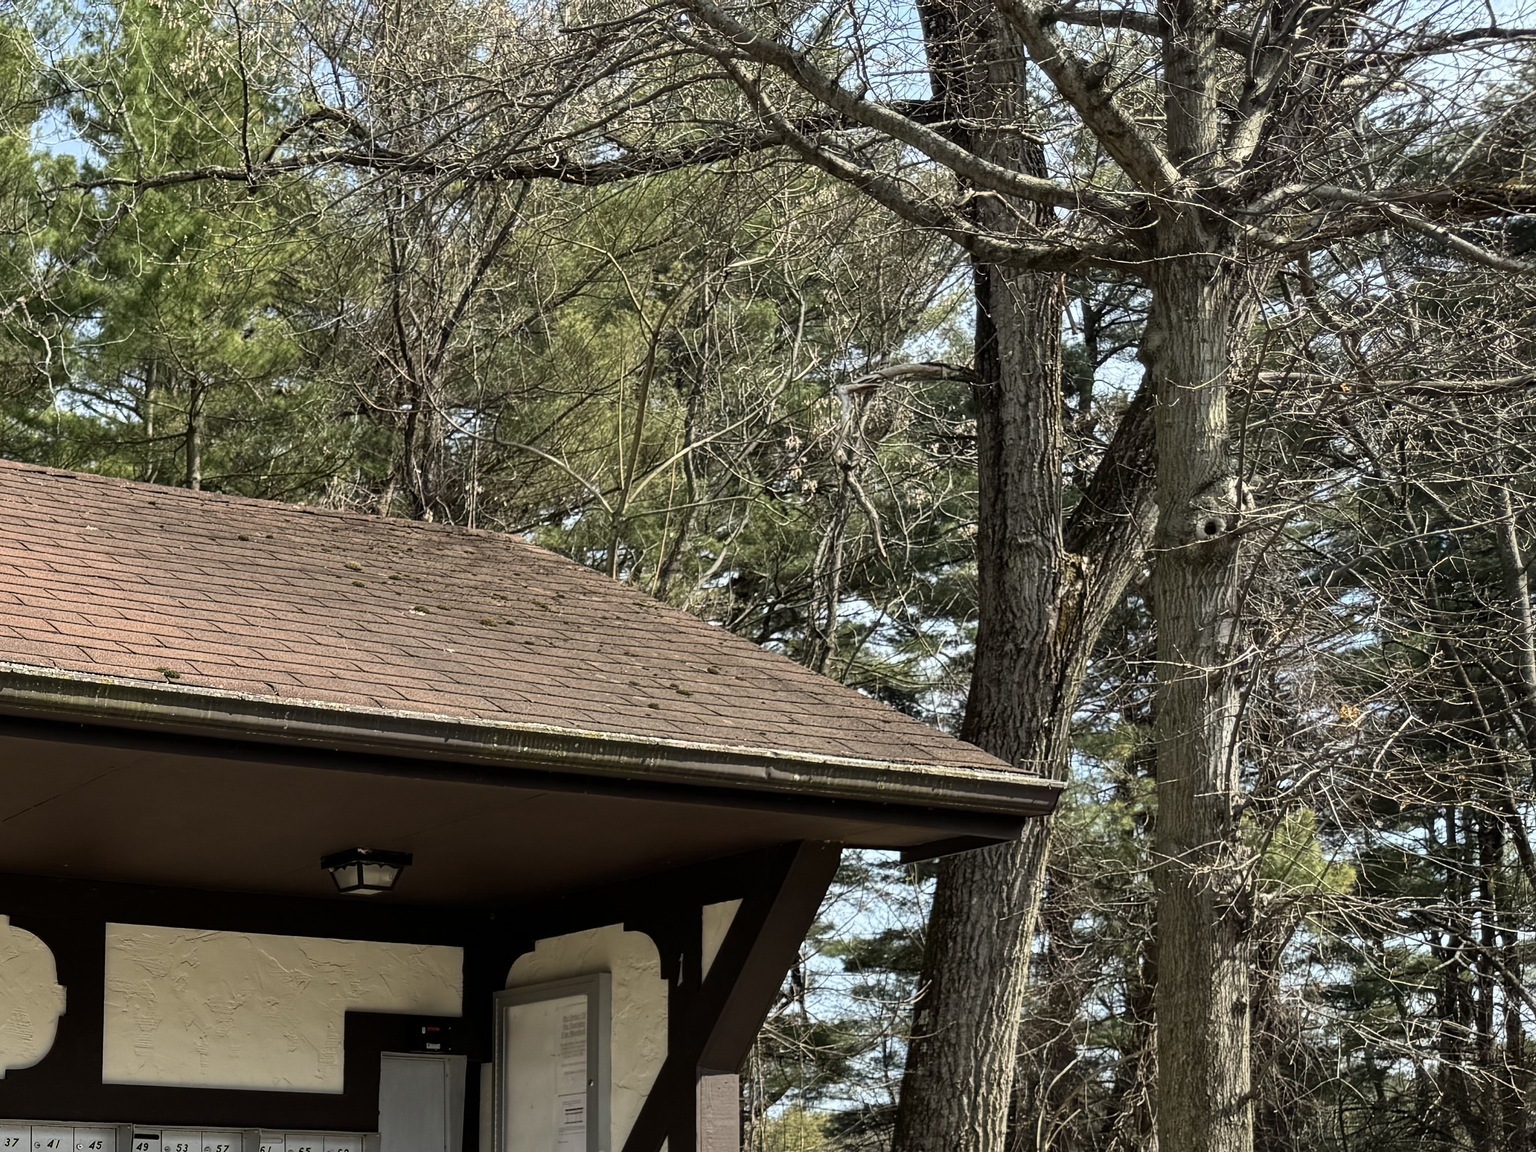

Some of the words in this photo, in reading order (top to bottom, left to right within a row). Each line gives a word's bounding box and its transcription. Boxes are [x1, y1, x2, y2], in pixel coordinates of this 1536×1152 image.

[3, 1137, 20, 1148] 37
[46, 1139, 61, 1150] 41
[88, 1140, 104, 1151] 45
[135, 1141, 150, 1152] 49
[175, 1143, 189, 1152] 53
